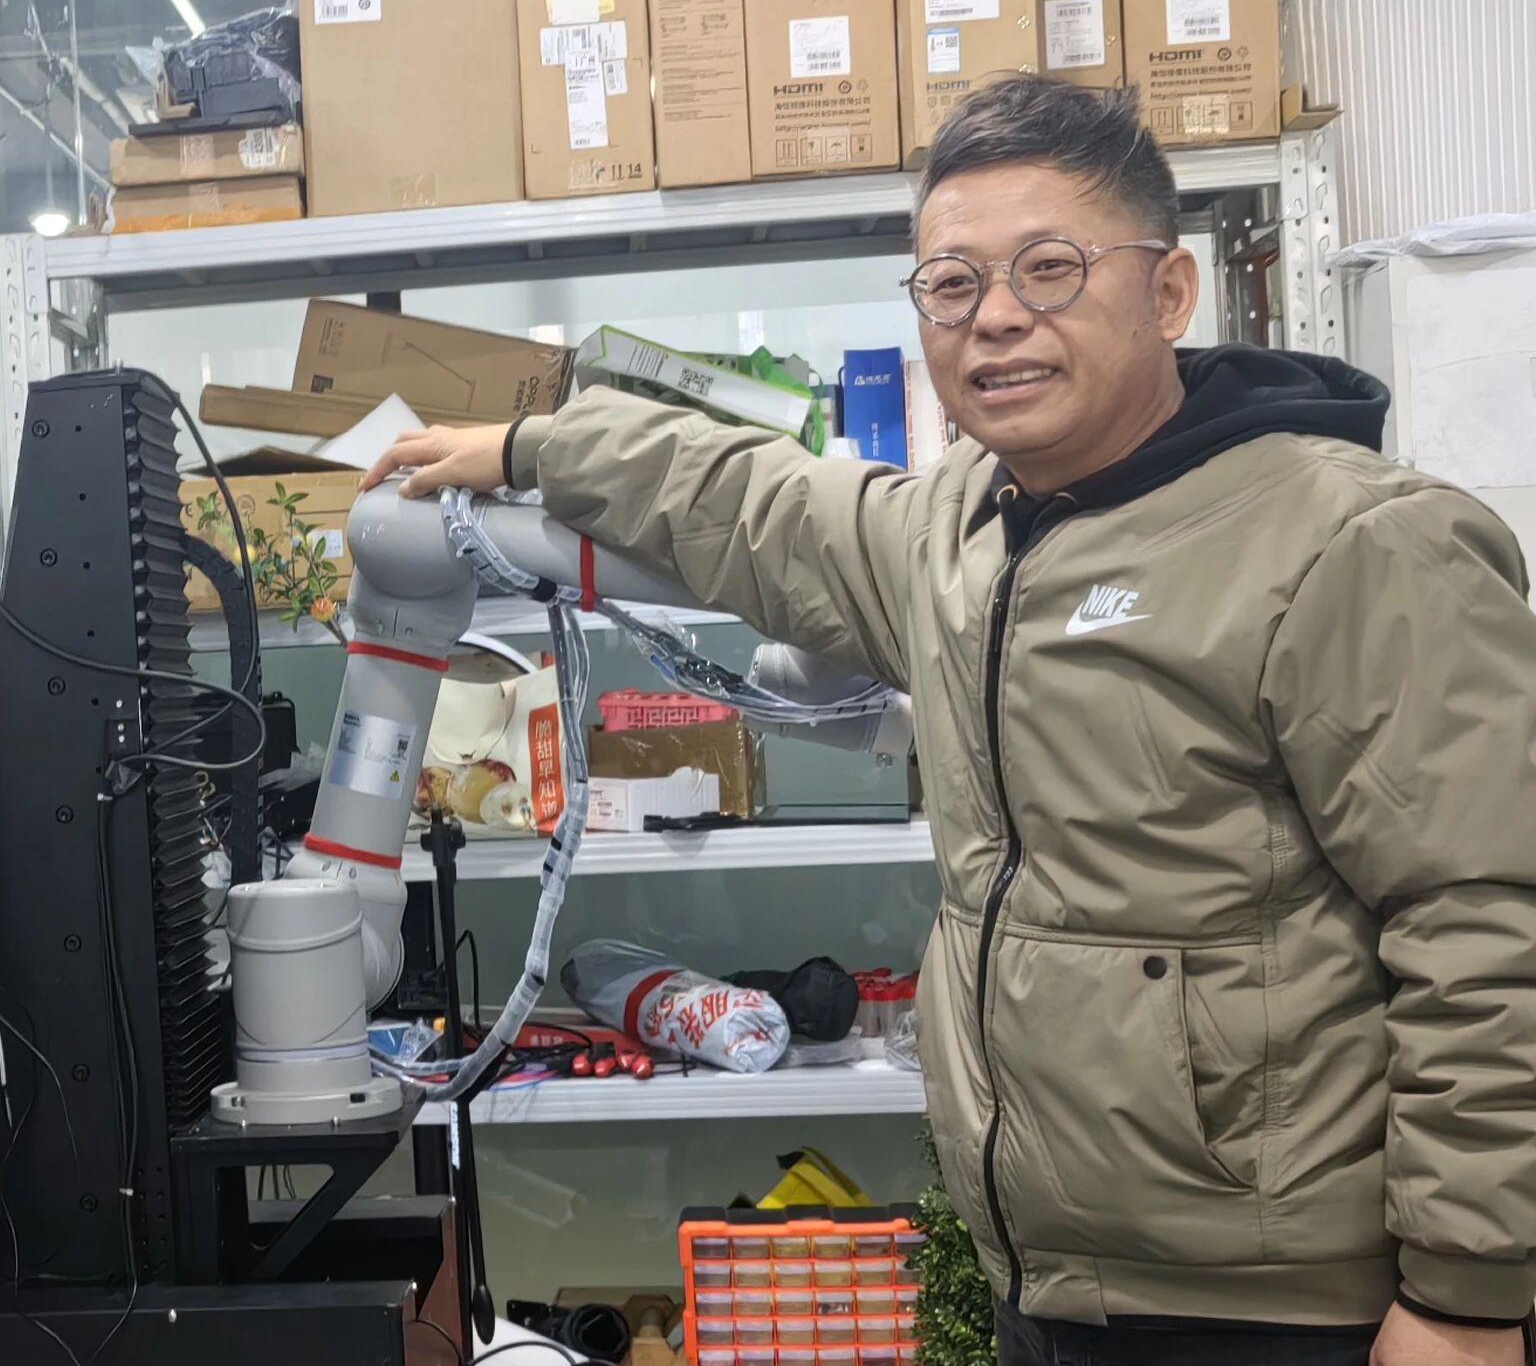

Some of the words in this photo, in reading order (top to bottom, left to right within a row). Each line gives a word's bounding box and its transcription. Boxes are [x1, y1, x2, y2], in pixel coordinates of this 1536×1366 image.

[1148, 48, 1202, 62] HDMI
[773, 82, 824, 96] HDMI
[1082, 584, 1140, 619] NIKE
